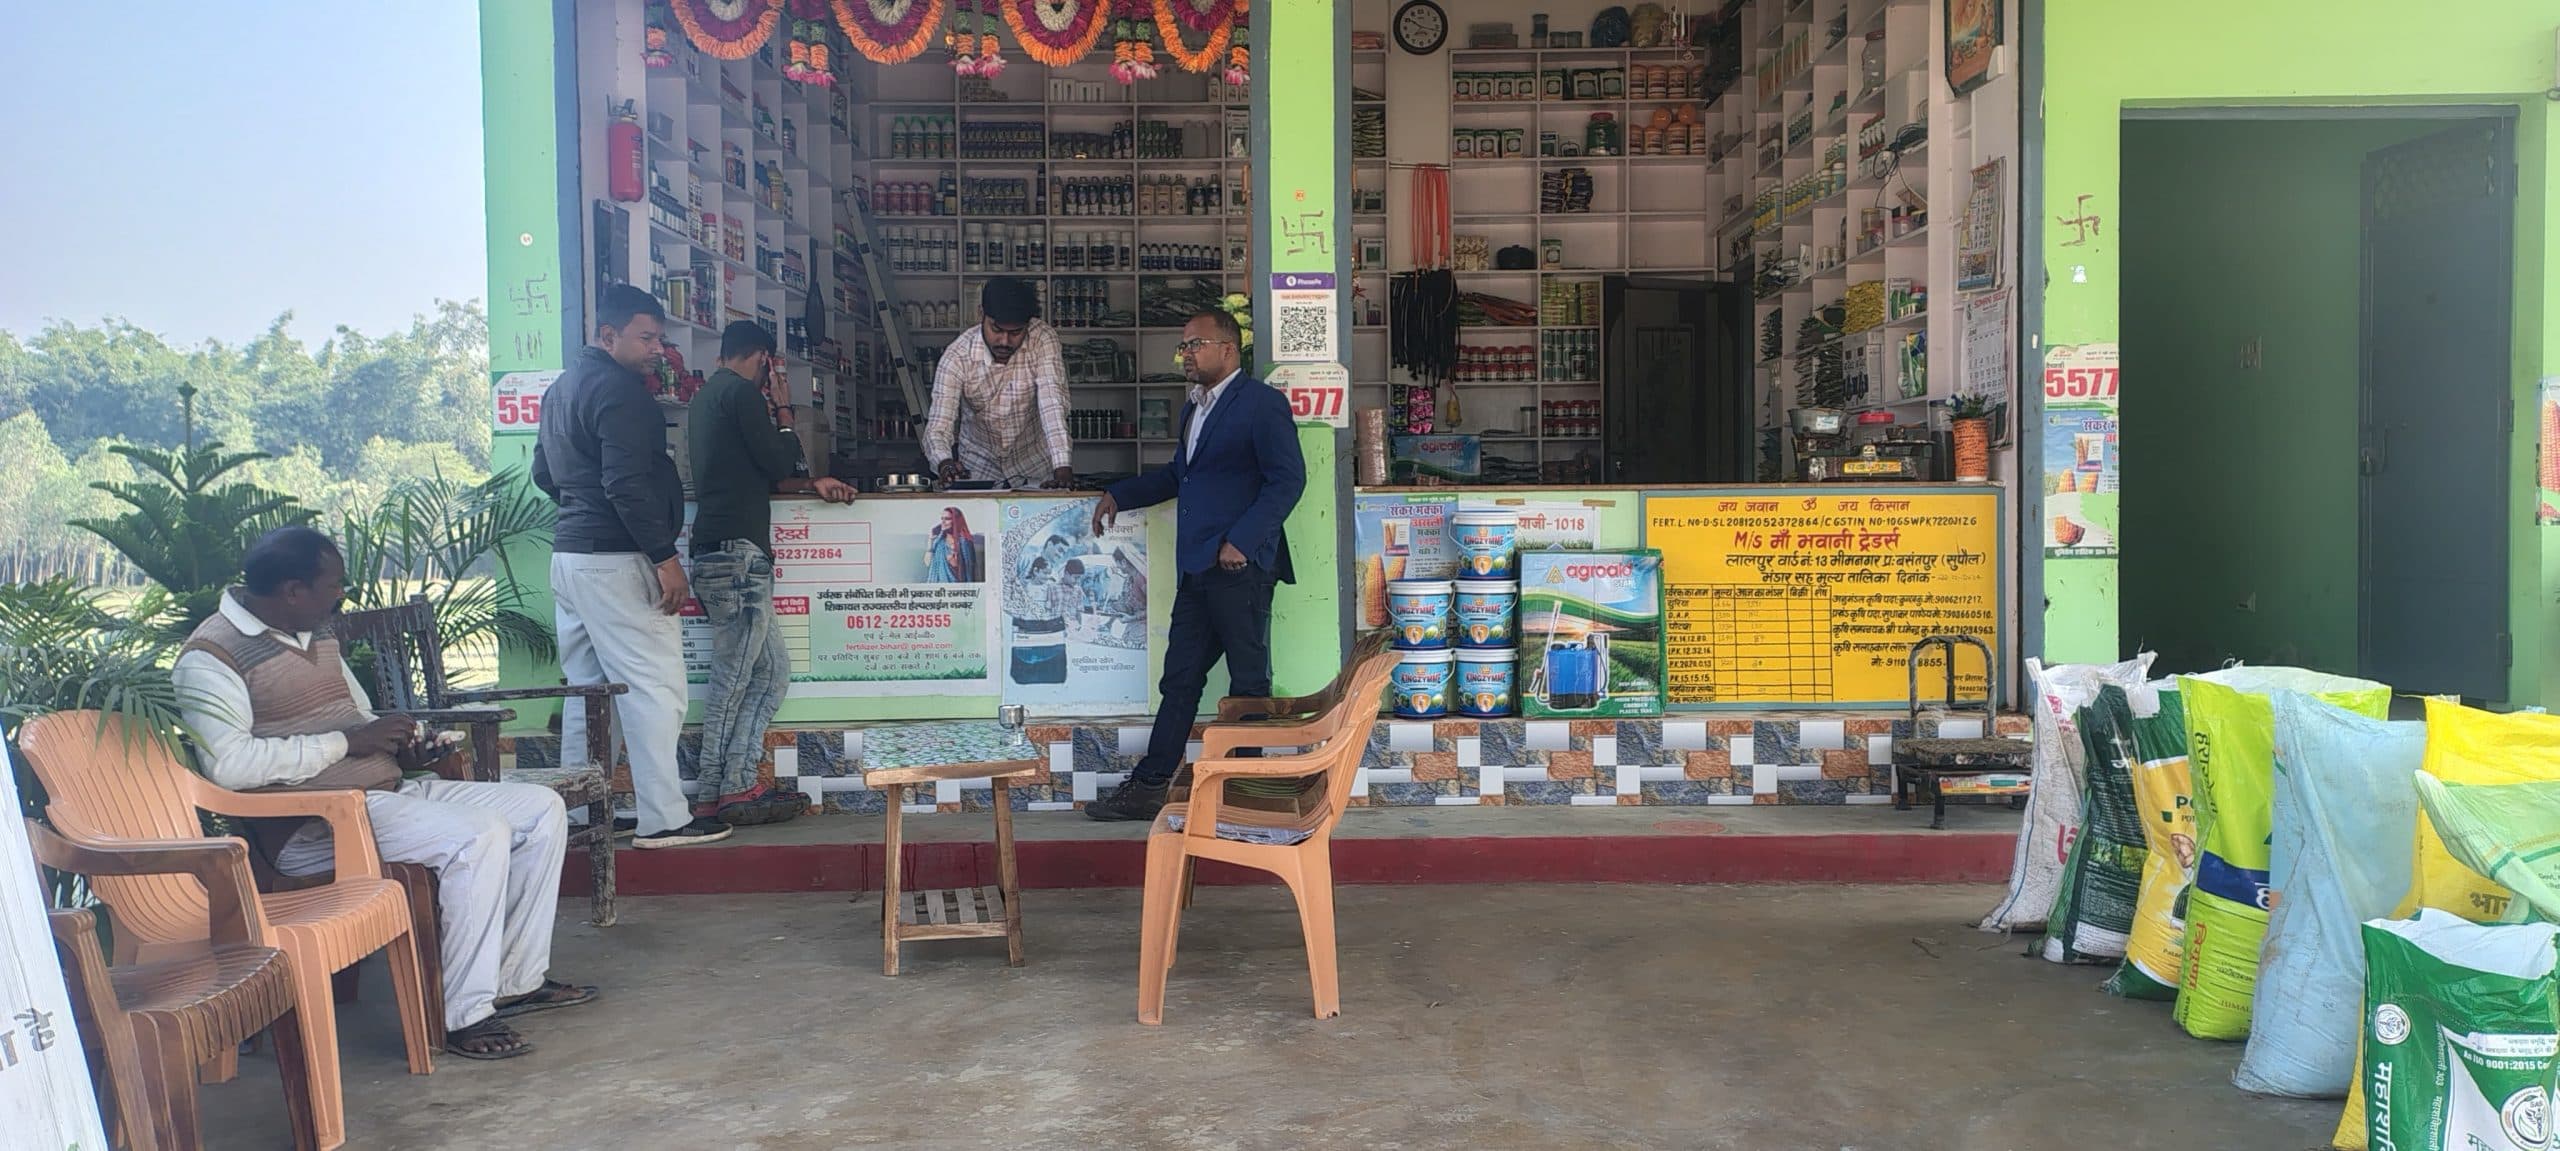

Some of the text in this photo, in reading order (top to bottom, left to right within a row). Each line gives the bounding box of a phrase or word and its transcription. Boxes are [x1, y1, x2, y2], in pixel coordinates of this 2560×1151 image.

[2046, 367, 2119, 397] 5577
[498, 396, 542, 424] 55
[1290, 387, 1344, 416] 577
[1718, 501, 1738, 513] जय
[1744, 501, 1781, 513] जवान
[1838, 501, 1859, 512] जय
[1869, 498, 1911, 512] किसान
[774, 525, 809, 543] ट्रेडर्स
[1797, 528, 1855, 551] भवानी
[1858, 527, 1902, 552] ट्रेडर्स
[1726, 554, 1776, 571] लालपुर
[1847, 569, 1890, 584] तालिका
[847, 614, 951, 629] 0612-2233555
[2486, 1059, 2536, 1070] 9001:2015
